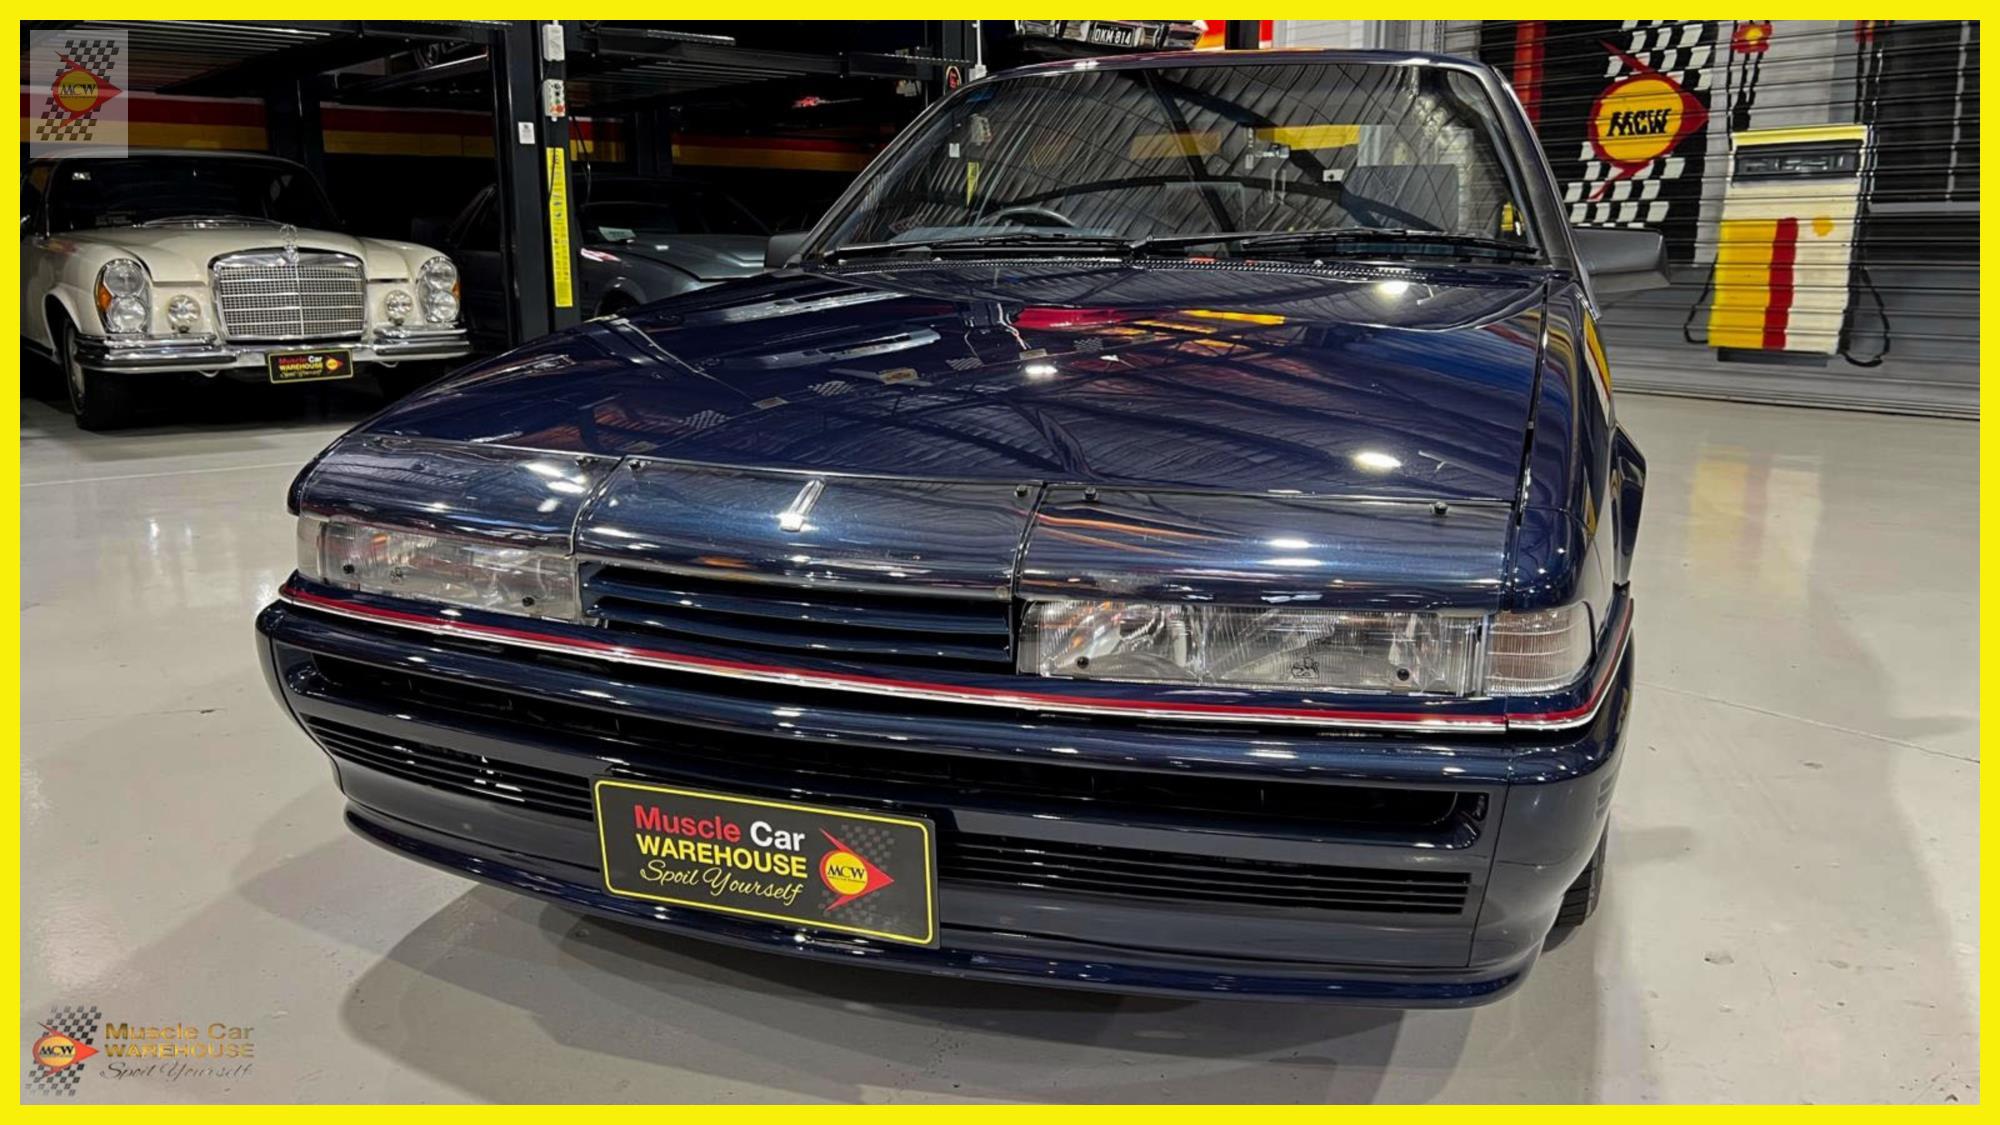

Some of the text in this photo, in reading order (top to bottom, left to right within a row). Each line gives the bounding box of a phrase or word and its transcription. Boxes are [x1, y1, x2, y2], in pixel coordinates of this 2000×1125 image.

[1114, 30, 1132, 45] 814
[1606, 108, 1672, 137] MCW
[634, 804, 806, 851] Muscle Car
[635, 833, 809, 879] WAREHOUSE
[827, 865, 865, 880] MCW
[639, 859, 804, 906] Spoil Yourself
